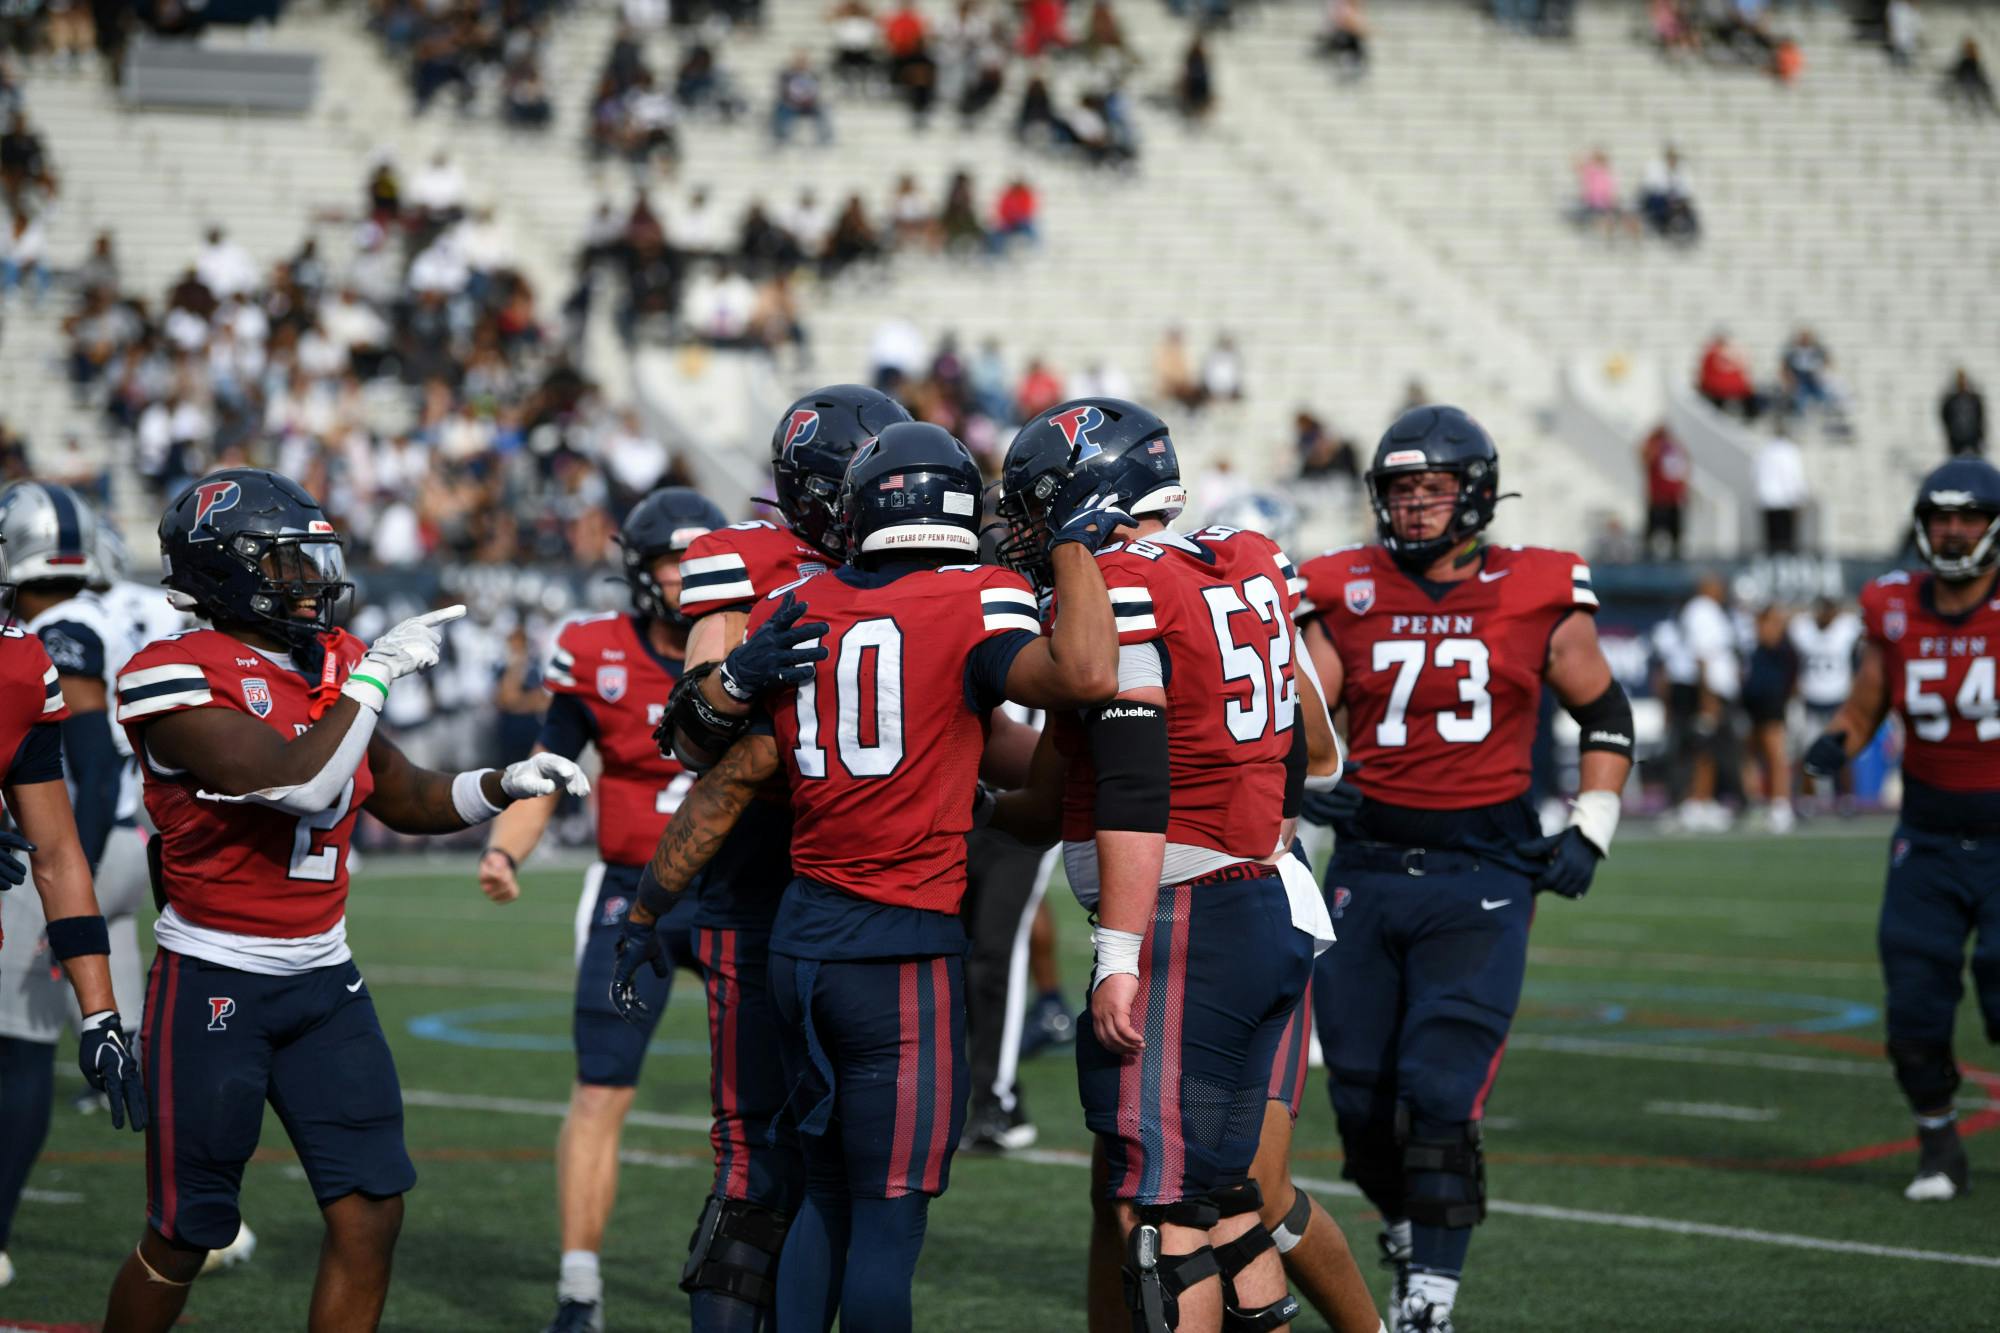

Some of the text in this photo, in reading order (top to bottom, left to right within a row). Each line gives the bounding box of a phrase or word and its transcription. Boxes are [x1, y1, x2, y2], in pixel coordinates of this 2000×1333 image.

[779, 410, 819, 473] P
[1048, 406, 1104, 464] P
[188, 481, 241, 543] P
[897, 533, 916, 543] YEARS
[918, 533, 927, 542] OF
[928, 533, 945, 542] PENN
[946, 534, 970, 545] FOOTBALL
[1391, 615, 1474, 634] PENN
[1919, 637, 1987, 656] PENN
[1200, 573, 1295, 745] 52
[787, 616, 906, 780] 10
[1372, 638, 1493, 747] 73
[1904, 656, 2000, 742] 54
[207, 997, 236, 1031] P
